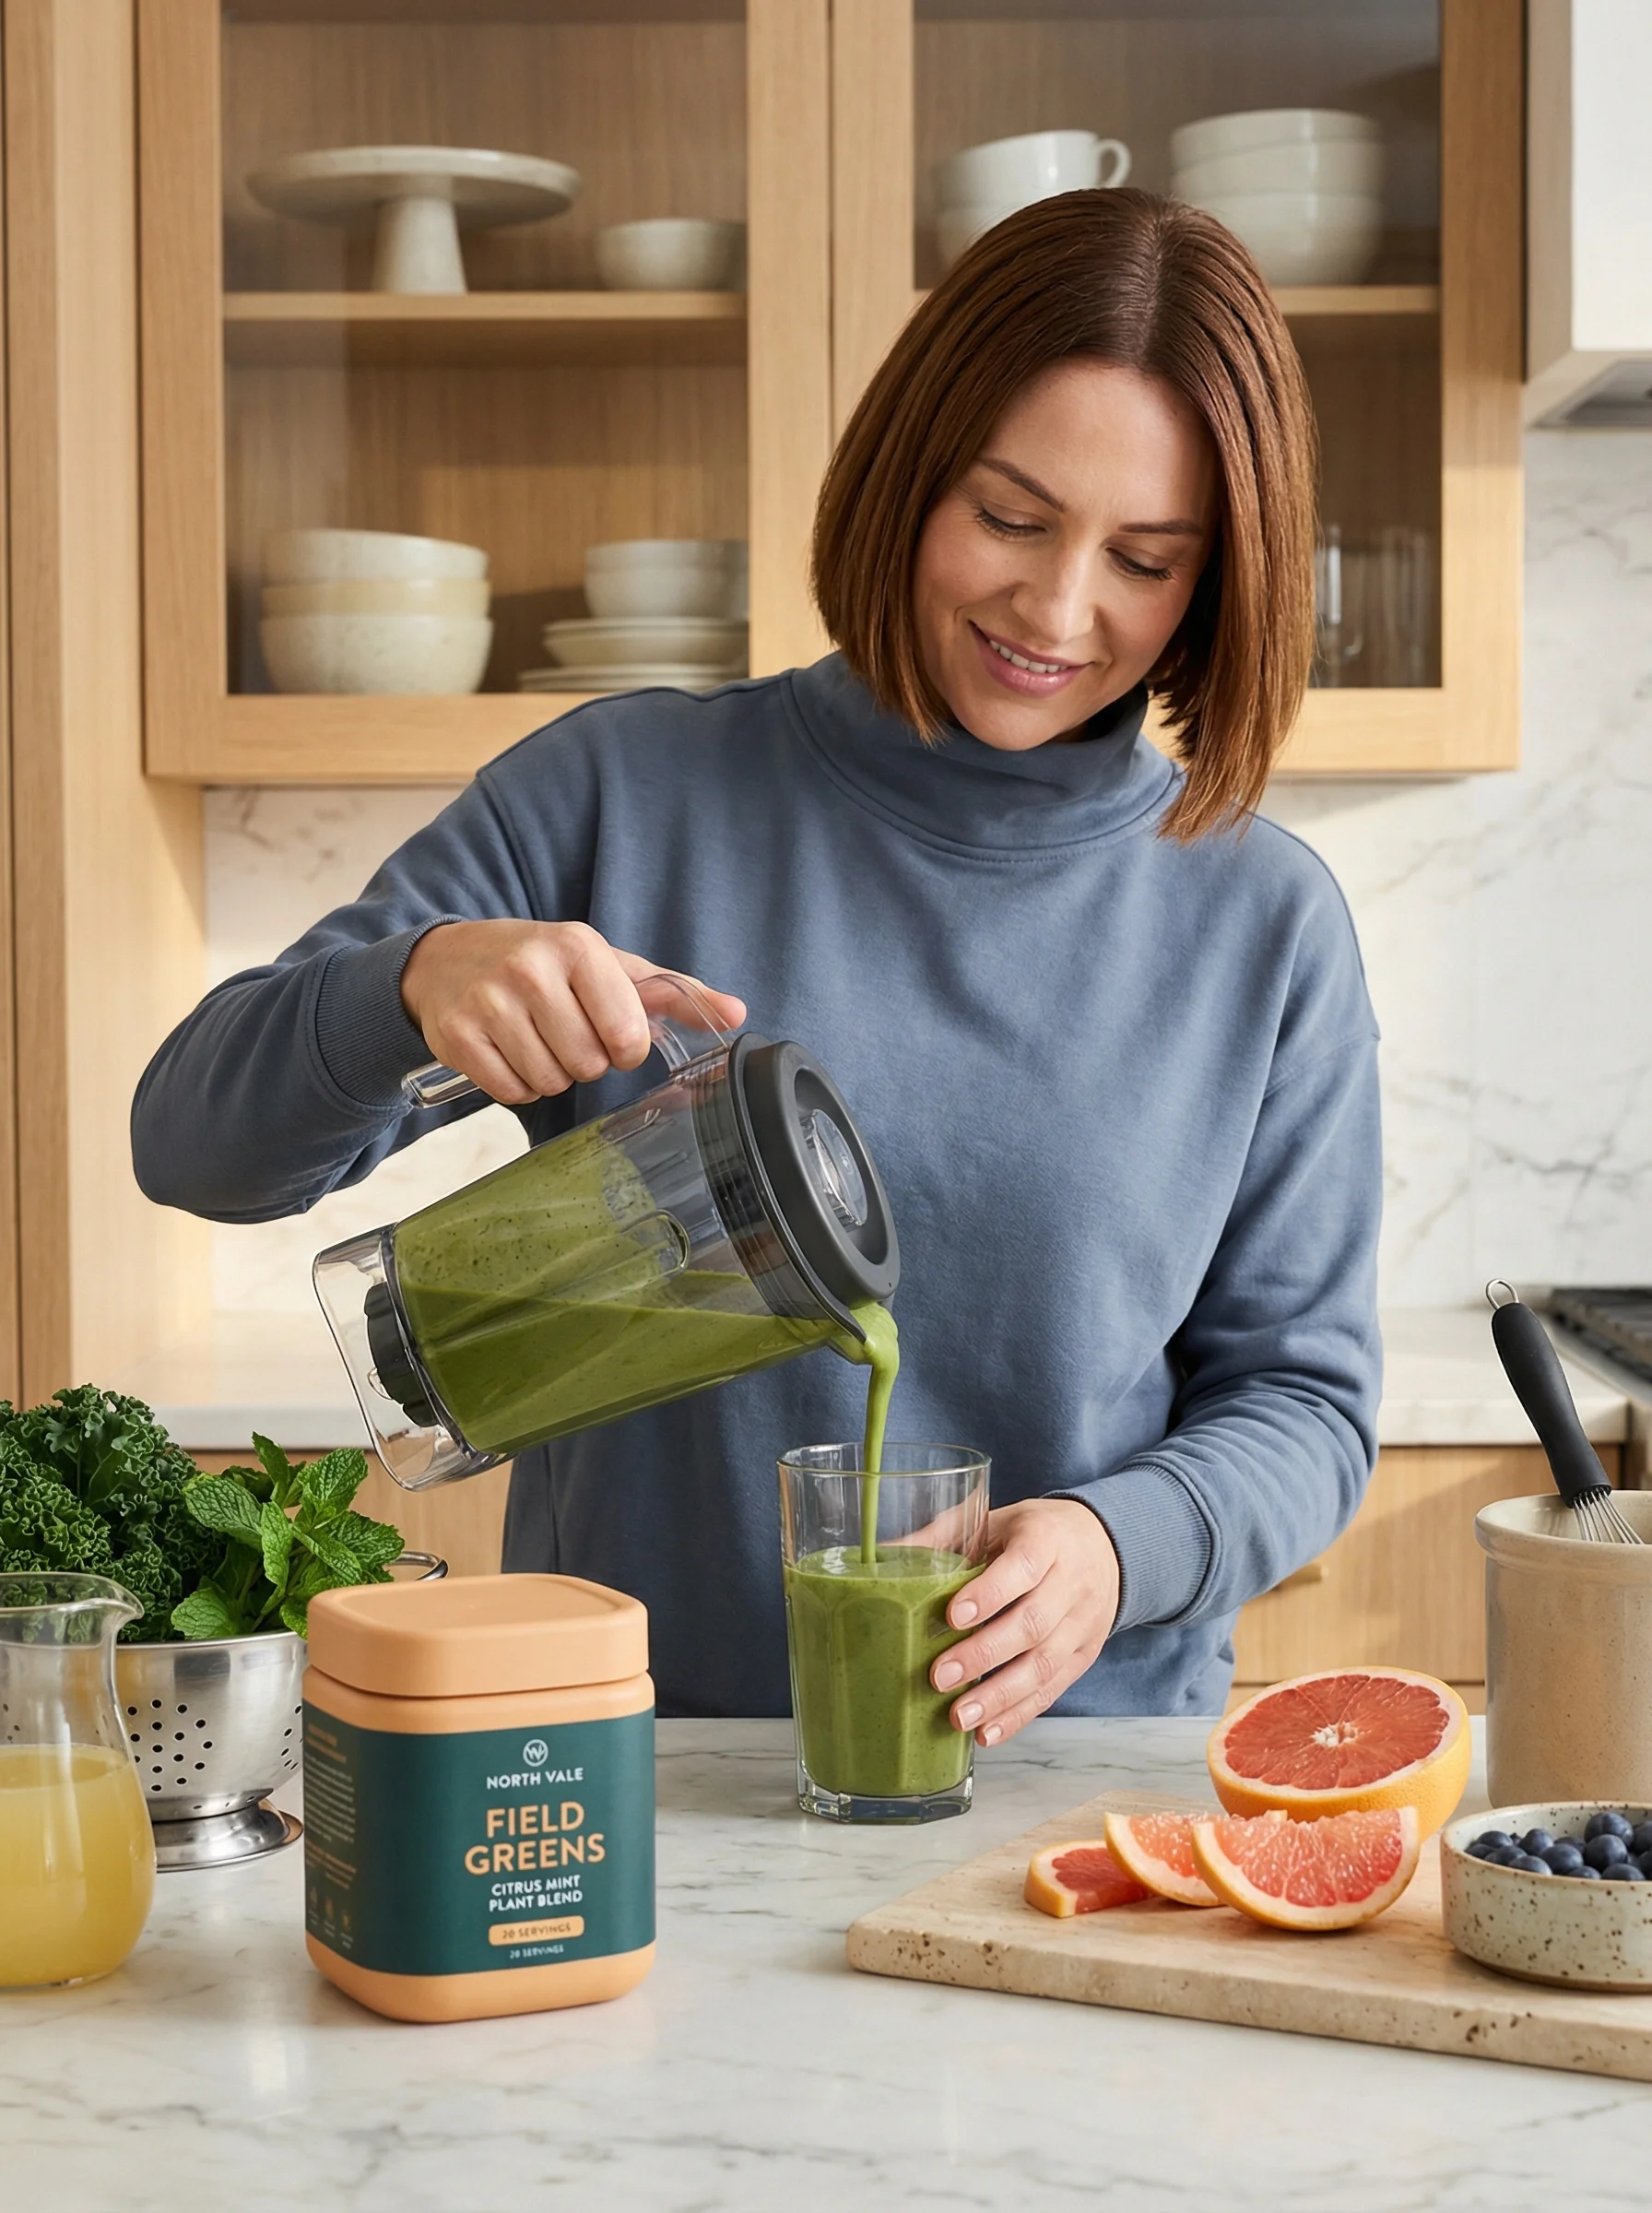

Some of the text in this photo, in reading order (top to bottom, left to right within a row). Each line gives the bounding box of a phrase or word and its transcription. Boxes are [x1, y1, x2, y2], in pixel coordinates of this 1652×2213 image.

[487, 1768, 584, 1790] NORTH VALE
[486, 1801, 584, 1839] FIELD
[465, 1833, 606, 1876] GREENS
[491, 1875, 581, 1897] CITRUS MINT
[489, 1890, 583, 1912] PLANT BLEND
[518, 1923, 571, 1937] SERVINGS
